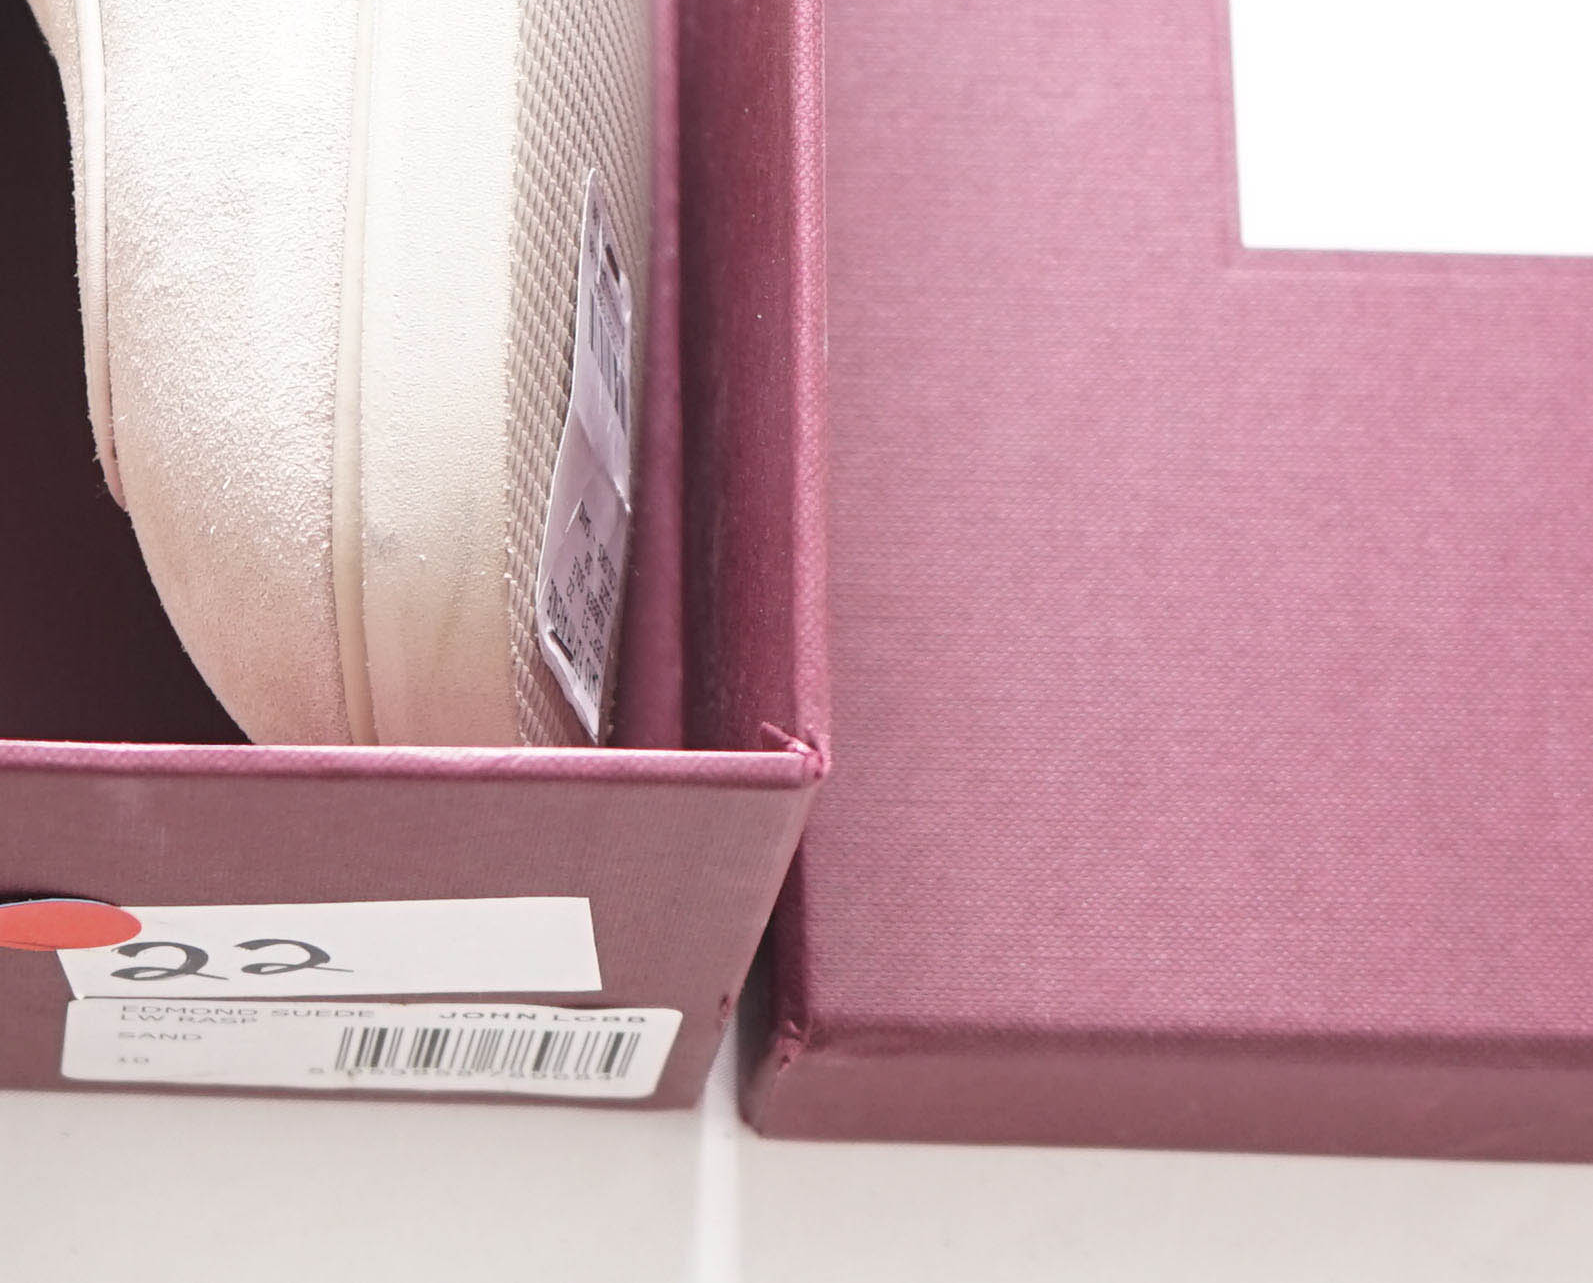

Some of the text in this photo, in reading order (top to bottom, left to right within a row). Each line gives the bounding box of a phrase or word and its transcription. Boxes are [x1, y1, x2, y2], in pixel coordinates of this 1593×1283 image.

[110, 938, 355, 982] 22
[121, 1004, 376, 1019] EDMOND SUEDE
[438, 1011, 538, 1021] JOHN
[178, 1016, 259, 1025] RASP
[117, 1031, 204, 1042] SAND
